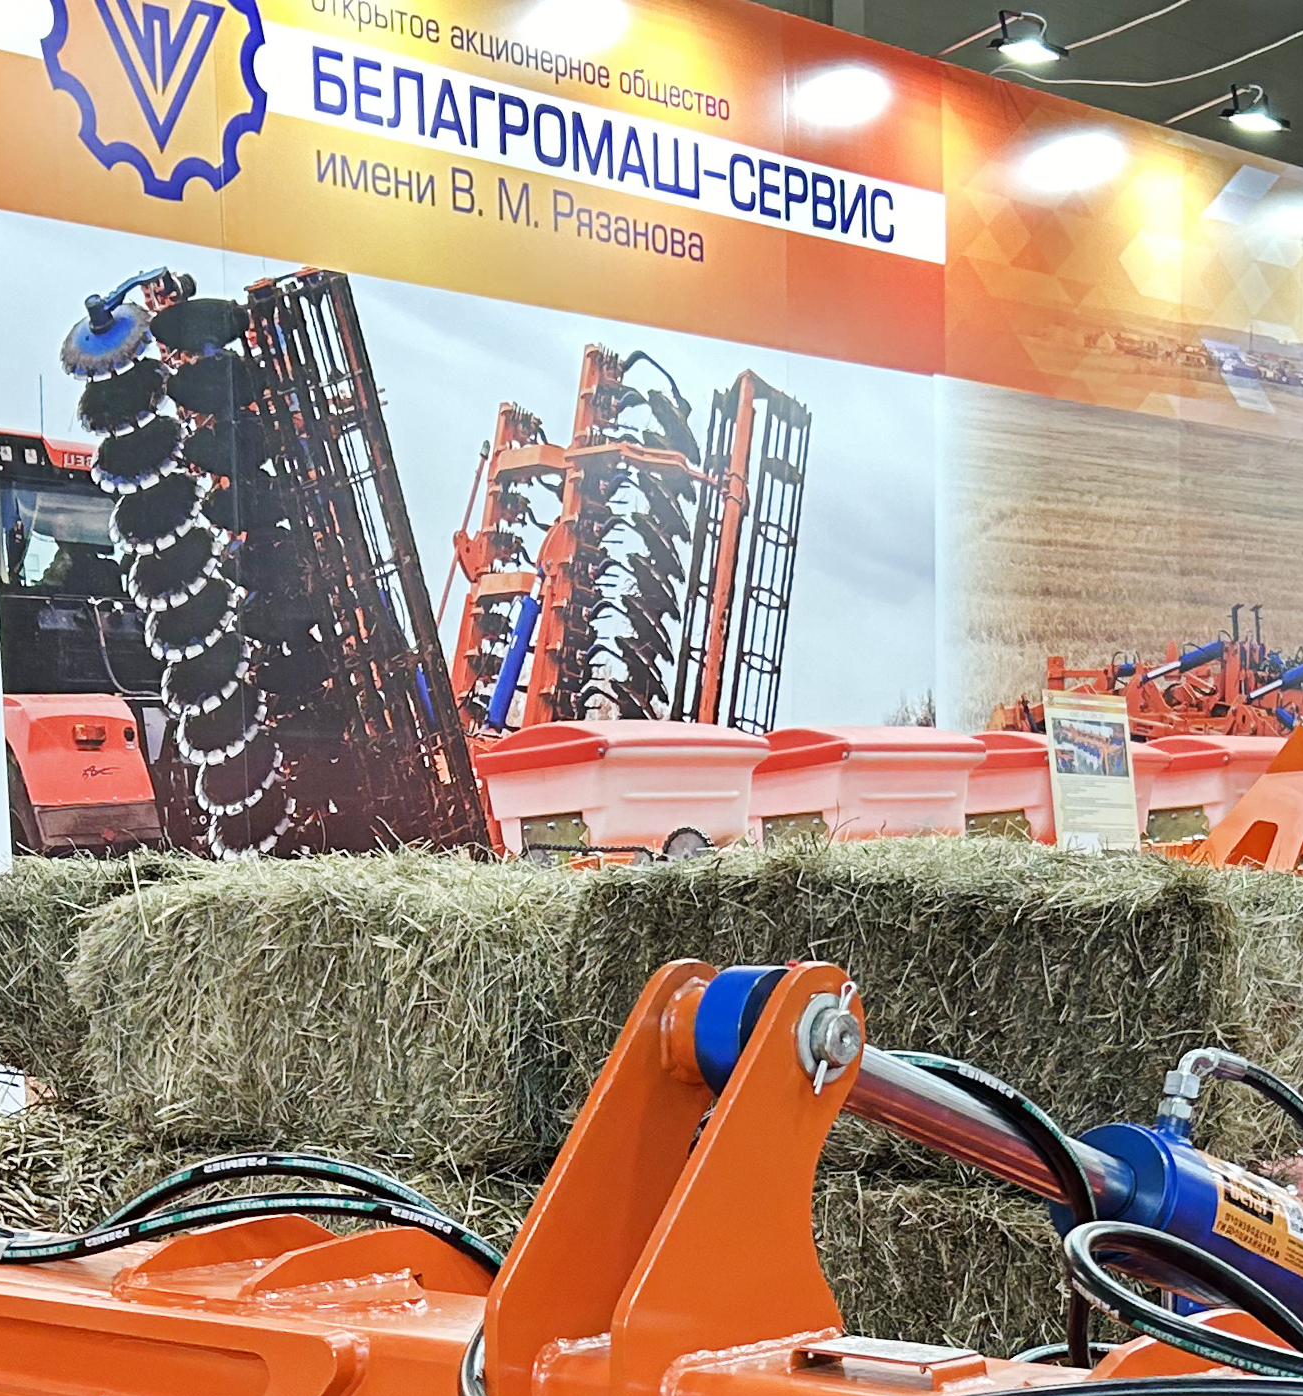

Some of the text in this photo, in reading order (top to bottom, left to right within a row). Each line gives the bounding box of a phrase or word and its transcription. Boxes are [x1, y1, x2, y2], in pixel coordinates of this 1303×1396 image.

[450, 25, 610, 90] акционерное
[619, 68, 730, 121] общество
[312, 45, 895, 244] БЕЛАГРОМАШ-СЕРВИС
[315, 148, 705, 264] имени В. М. Рязанова
[203, 1157, 268, 1174] PREMIER
[84, 1227, 130, 1248] PREMIER
[391, 1205, 452, 1235] PREMIER
